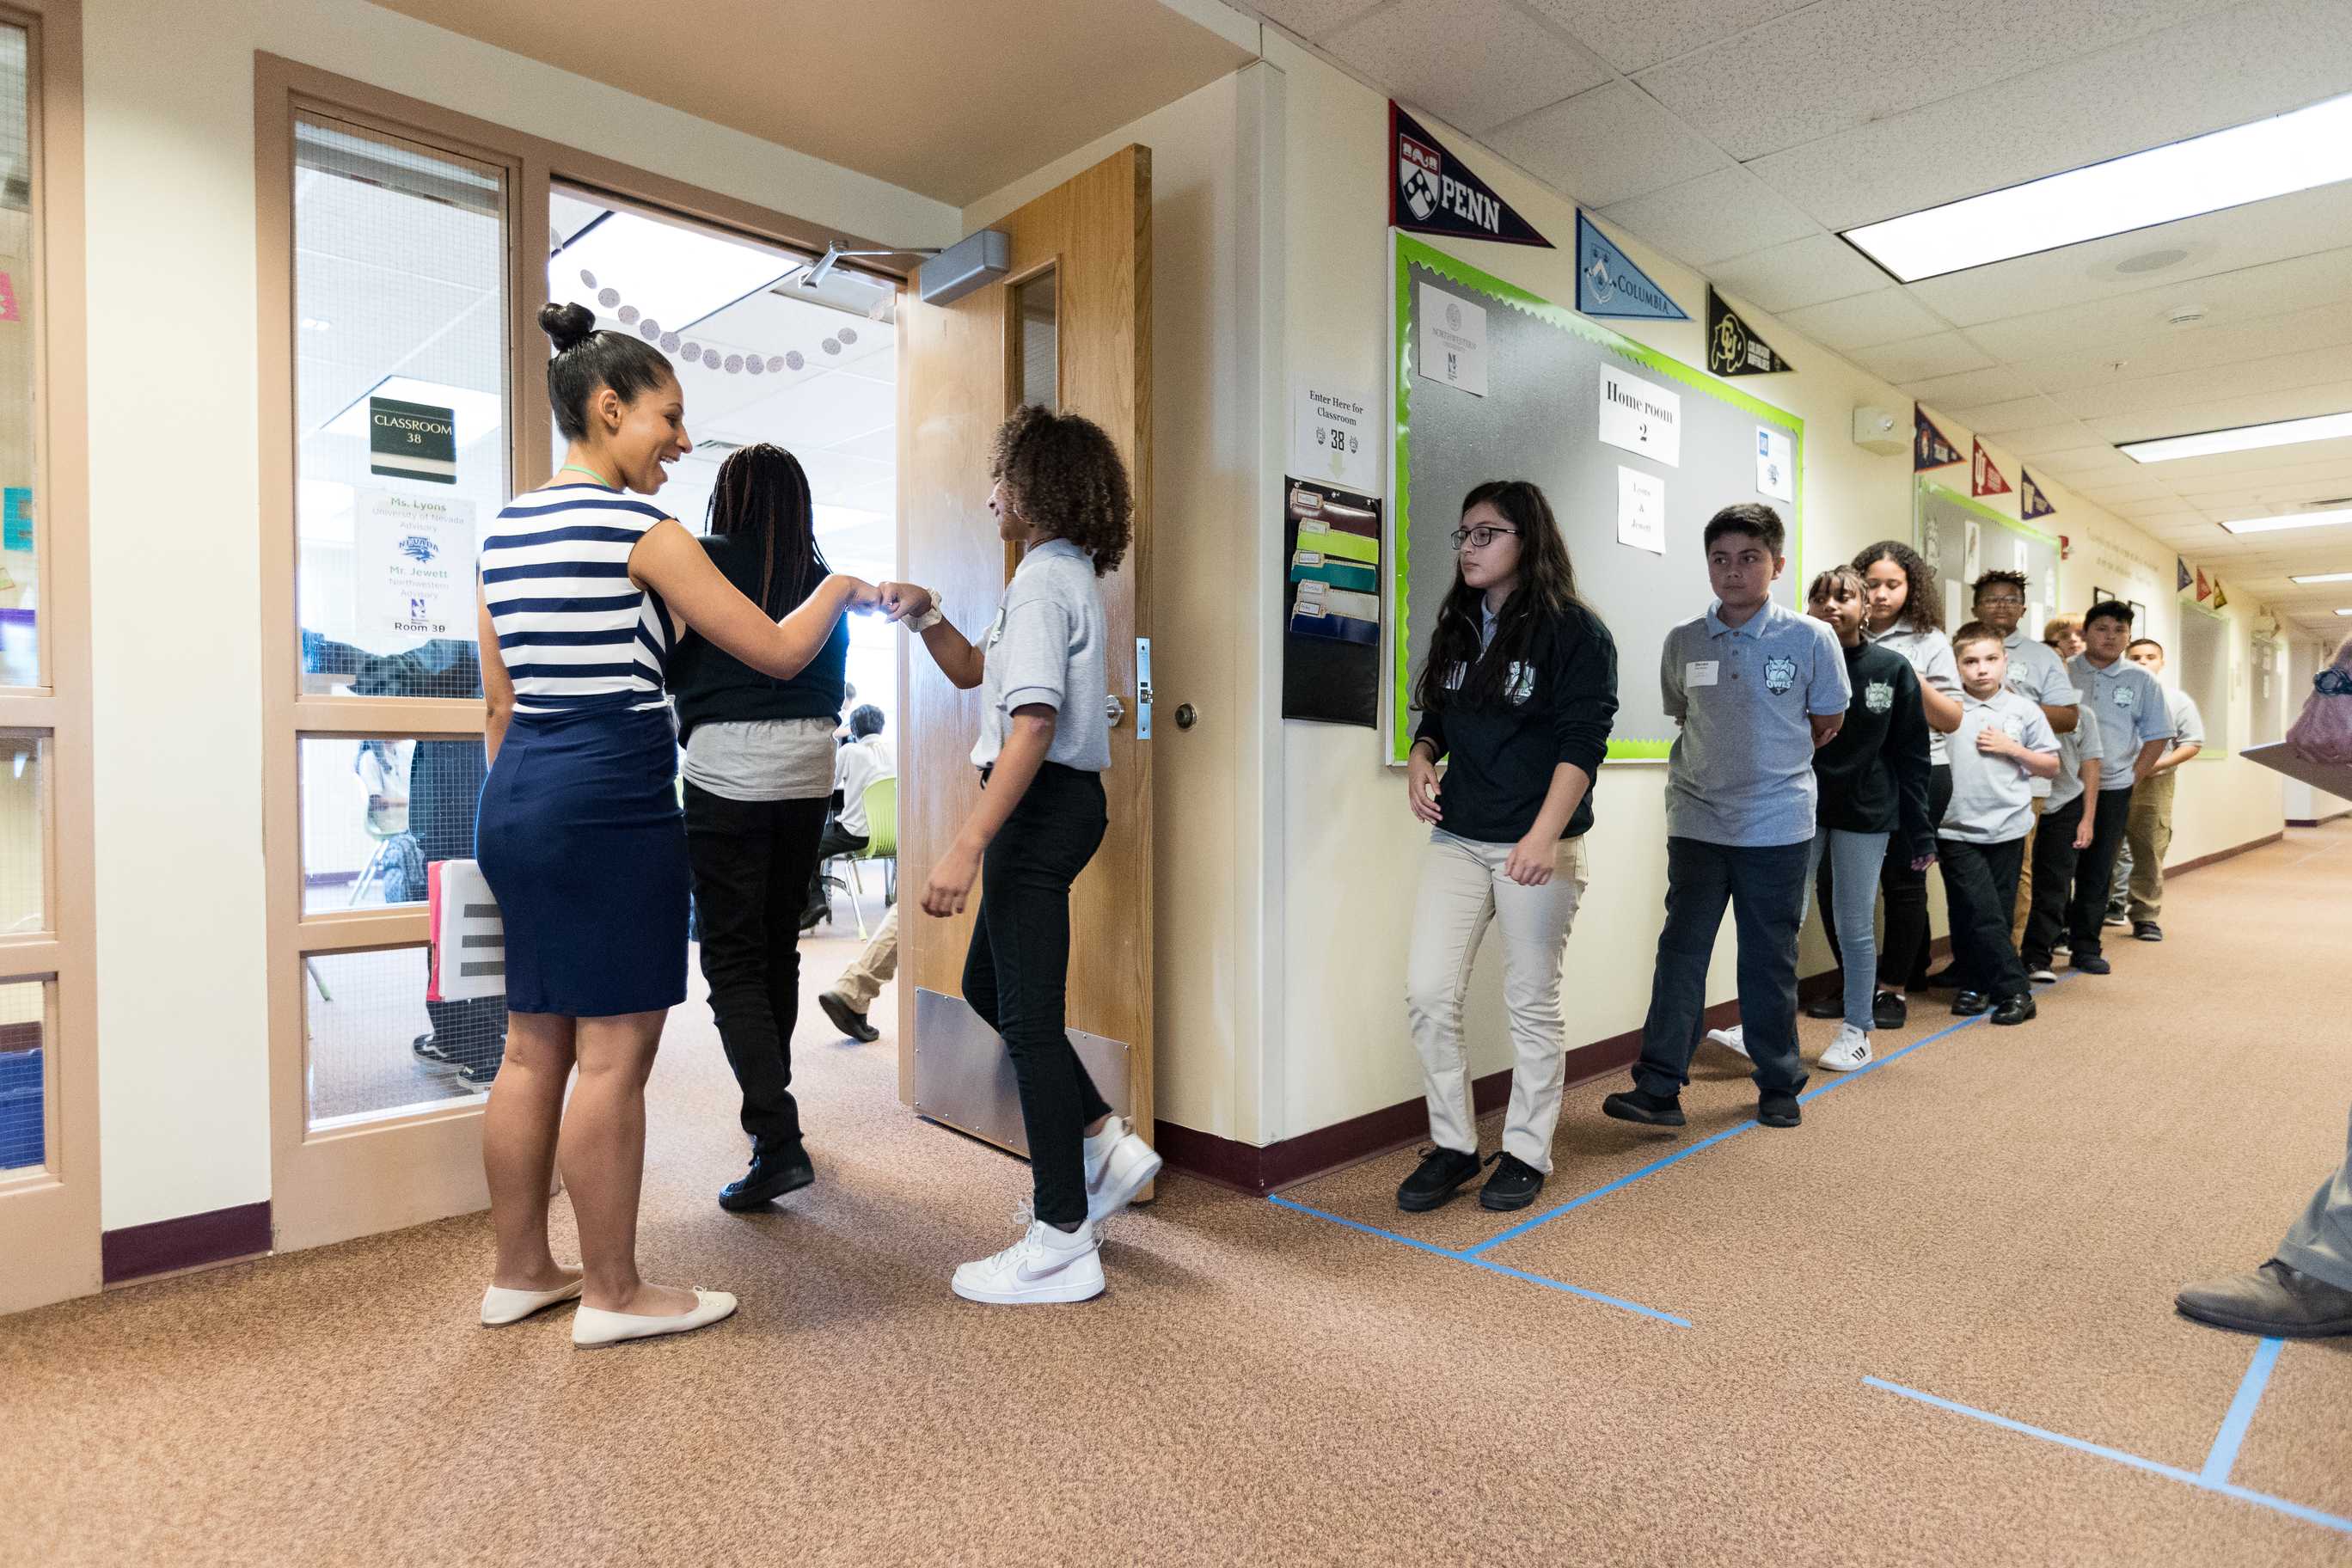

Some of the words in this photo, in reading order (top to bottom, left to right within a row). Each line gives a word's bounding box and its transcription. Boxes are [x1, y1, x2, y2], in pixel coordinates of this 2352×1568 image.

[1441, 174, 1500, 235] PENN
[1617, 274, 1669, 315] COLUMBIA
[1309, 389, 1332, 405] Enter
[1332, 396, 1351, 411] Here
[1352, 402, 1363, 414] for
[1607, 380, 1643, 413] Home
[1645, 401, 1673, 424] room
[374, 414, 452, 436] CLASSROOM
[1317, 407, 1357, 426] Classroom
[407, 432, 421, 444] 38
[1331, 429, 1344, 450] 38
[1639, 423, 1647, 442] 2
[391, 498, 410, 508] Ms.
[413, 499, 447, 511] Lyons
[399, 538, 439, 552] NEVADA
[410, 567, 448, 579] Jewett
[395, 622, 428, 633] Room
[432, 624, 446, 634] 38
[1766, 679, 1793, 689] OWLS
[1865, 700, 1892, 709] OWLS
